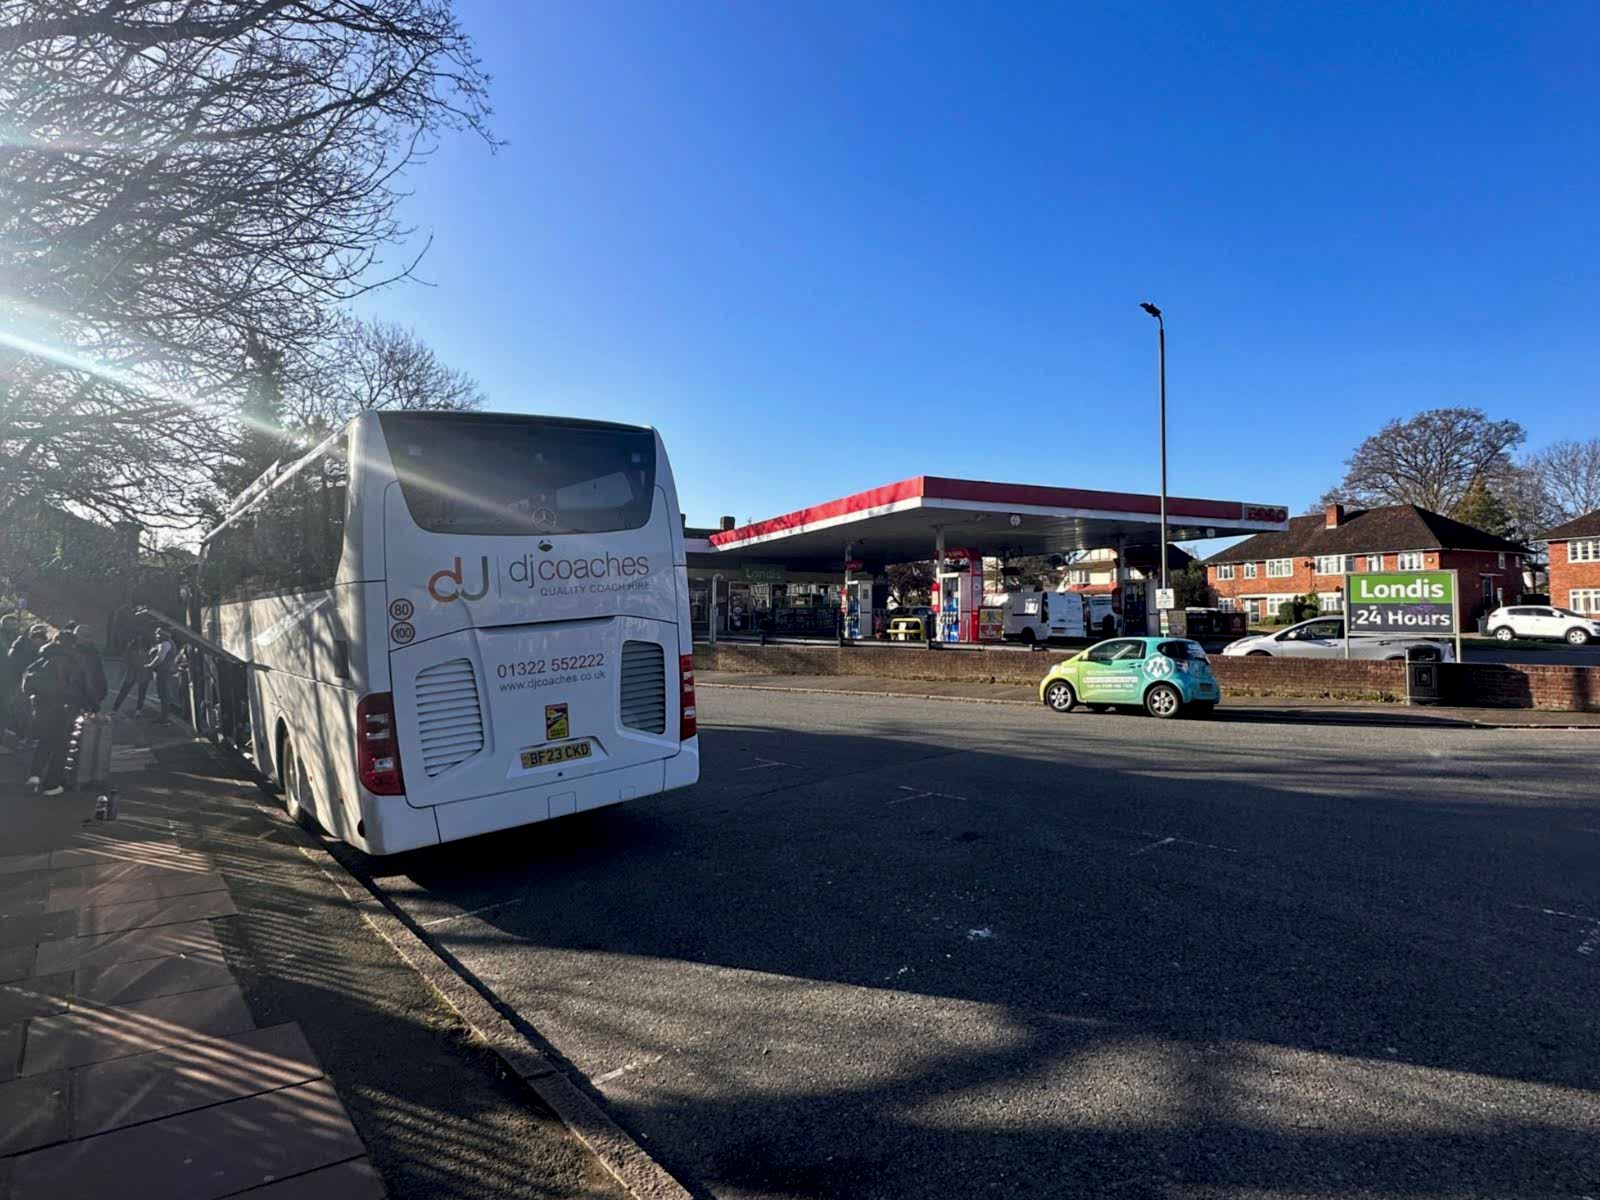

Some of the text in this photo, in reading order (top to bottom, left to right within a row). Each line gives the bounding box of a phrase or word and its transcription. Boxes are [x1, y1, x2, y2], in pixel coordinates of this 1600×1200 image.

[540, 581, 650, 596] QUALITY COACH HIRE
[1361, 578, 1444, 598] Londis
[395, 603, 409, 616] 80
[1357, 609, 1451, 625] 24 Hours
[395, 627, 411, 640] 100
[497, 653, 604, 678] 01322 552222
[530, 743, 589, 765] BF23 CKD
